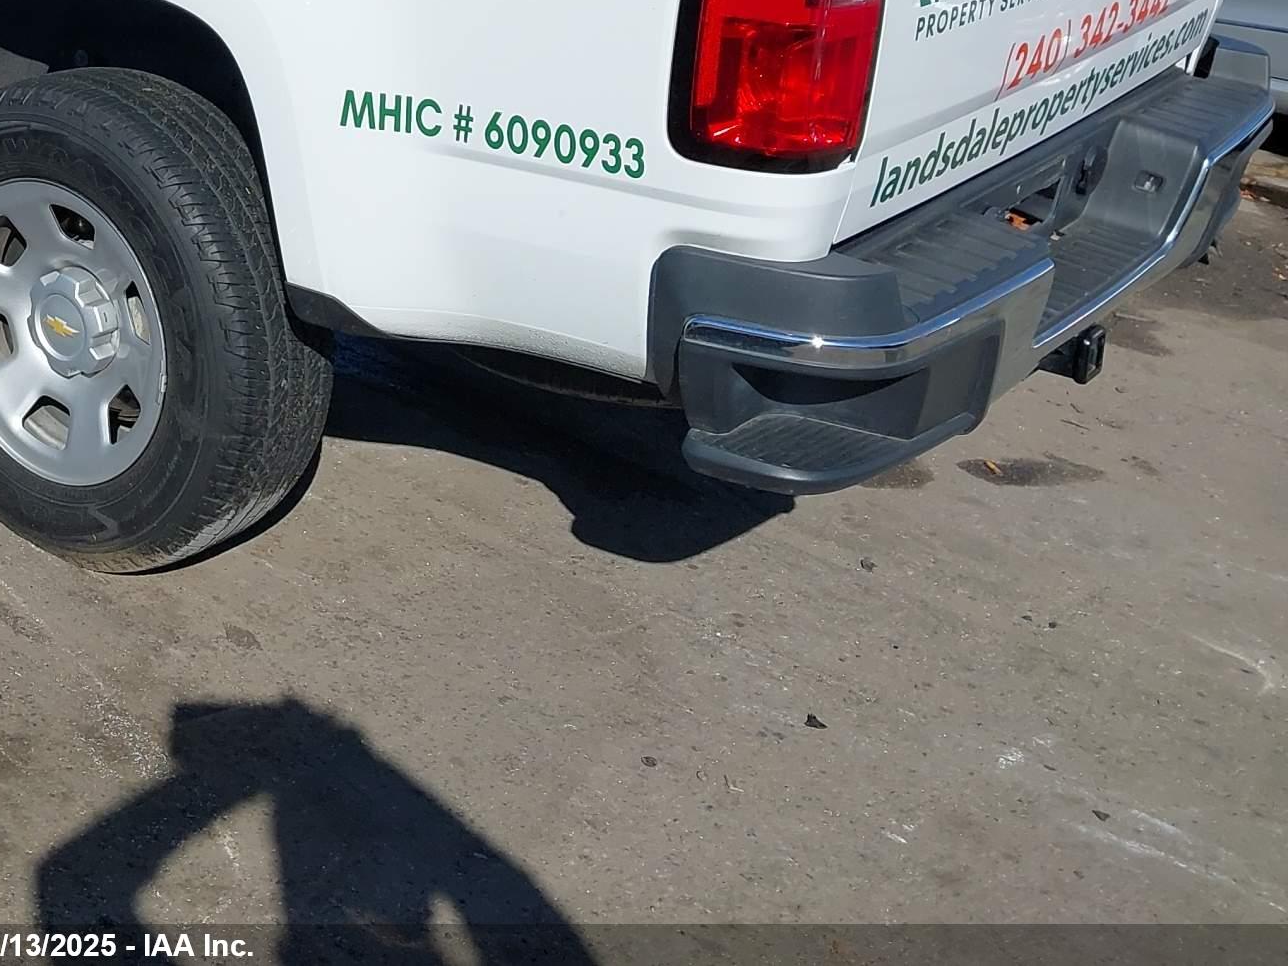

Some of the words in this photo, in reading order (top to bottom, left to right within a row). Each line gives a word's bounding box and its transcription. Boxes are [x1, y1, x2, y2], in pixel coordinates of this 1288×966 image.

[995, 19, 1071, 102] (240)
[340, 89, 442, 137] MHIC
[452, 104, 474, 143] #
[484, 111, 646, 179] 6090933
[870, 6, 1210, 208] landsdalepropertyservices.com
